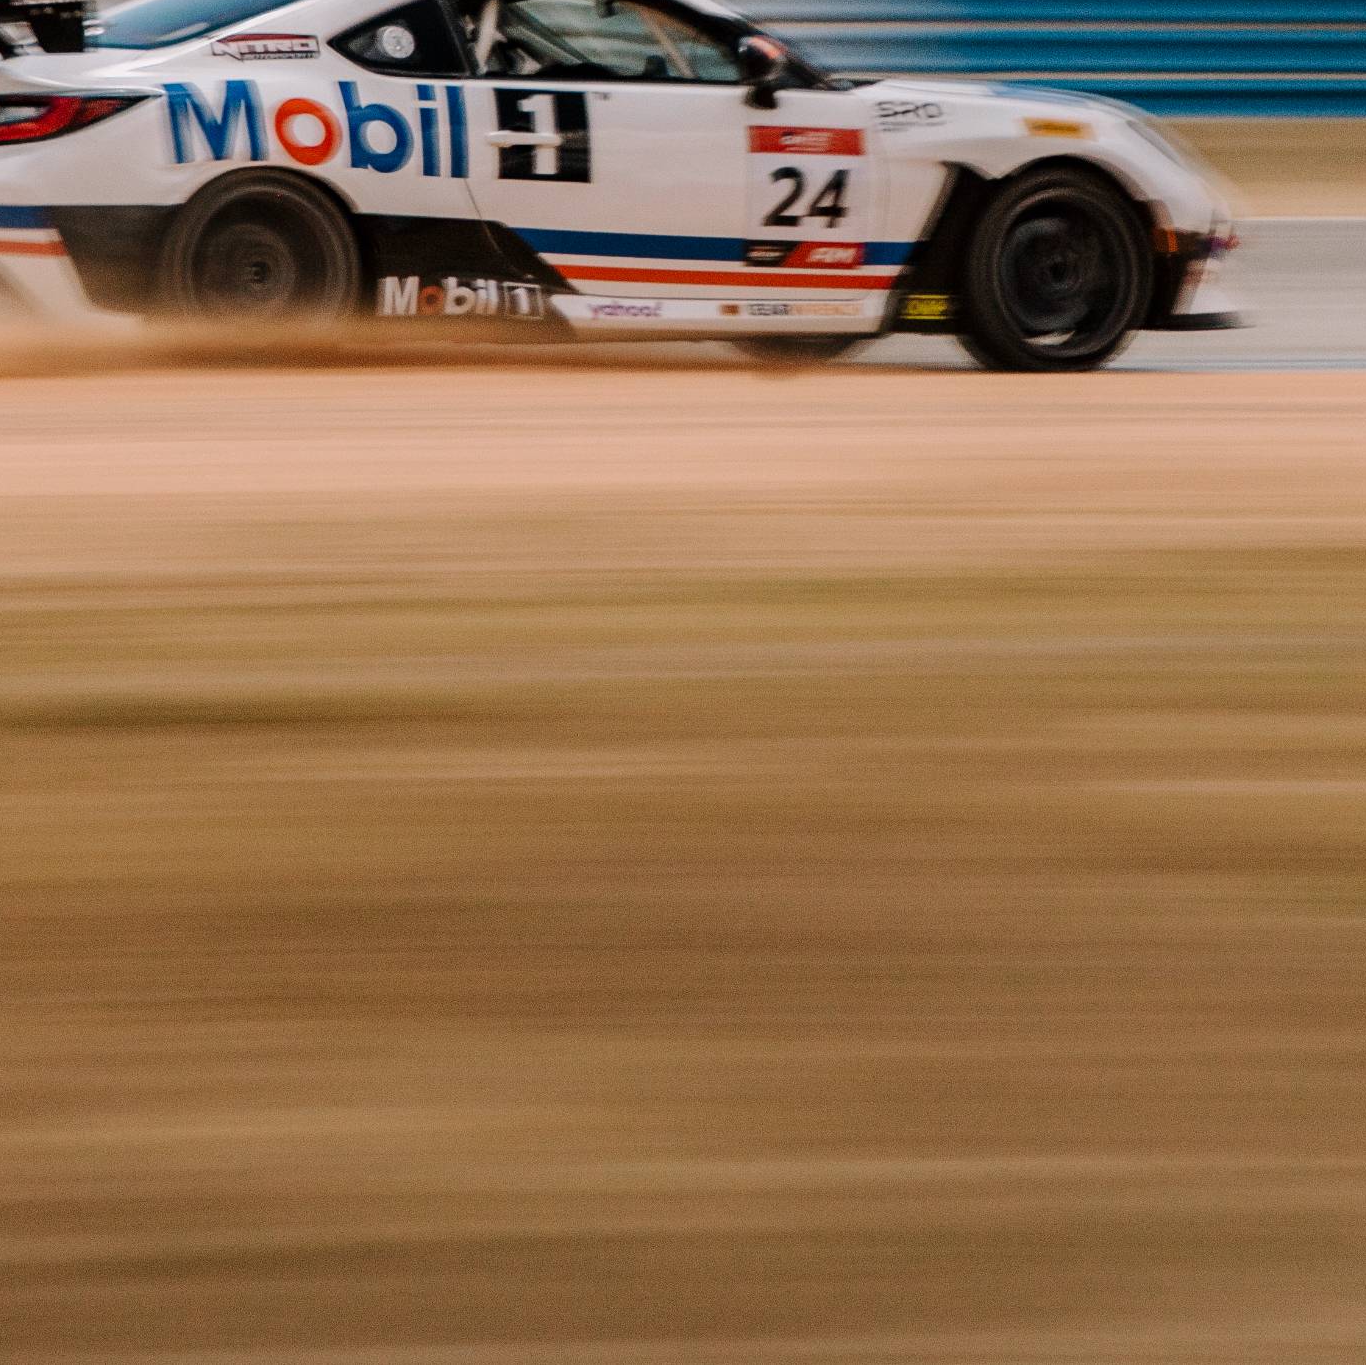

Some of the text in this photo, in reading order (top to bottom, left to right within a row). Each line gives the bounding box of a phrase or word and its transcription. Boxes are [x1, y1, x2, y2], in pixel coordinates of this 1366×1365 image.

[162, 80, 558, 178] Mobil 1
[762, 167, 851, 228] 24
[376, 276, 499, 316] Mobil
